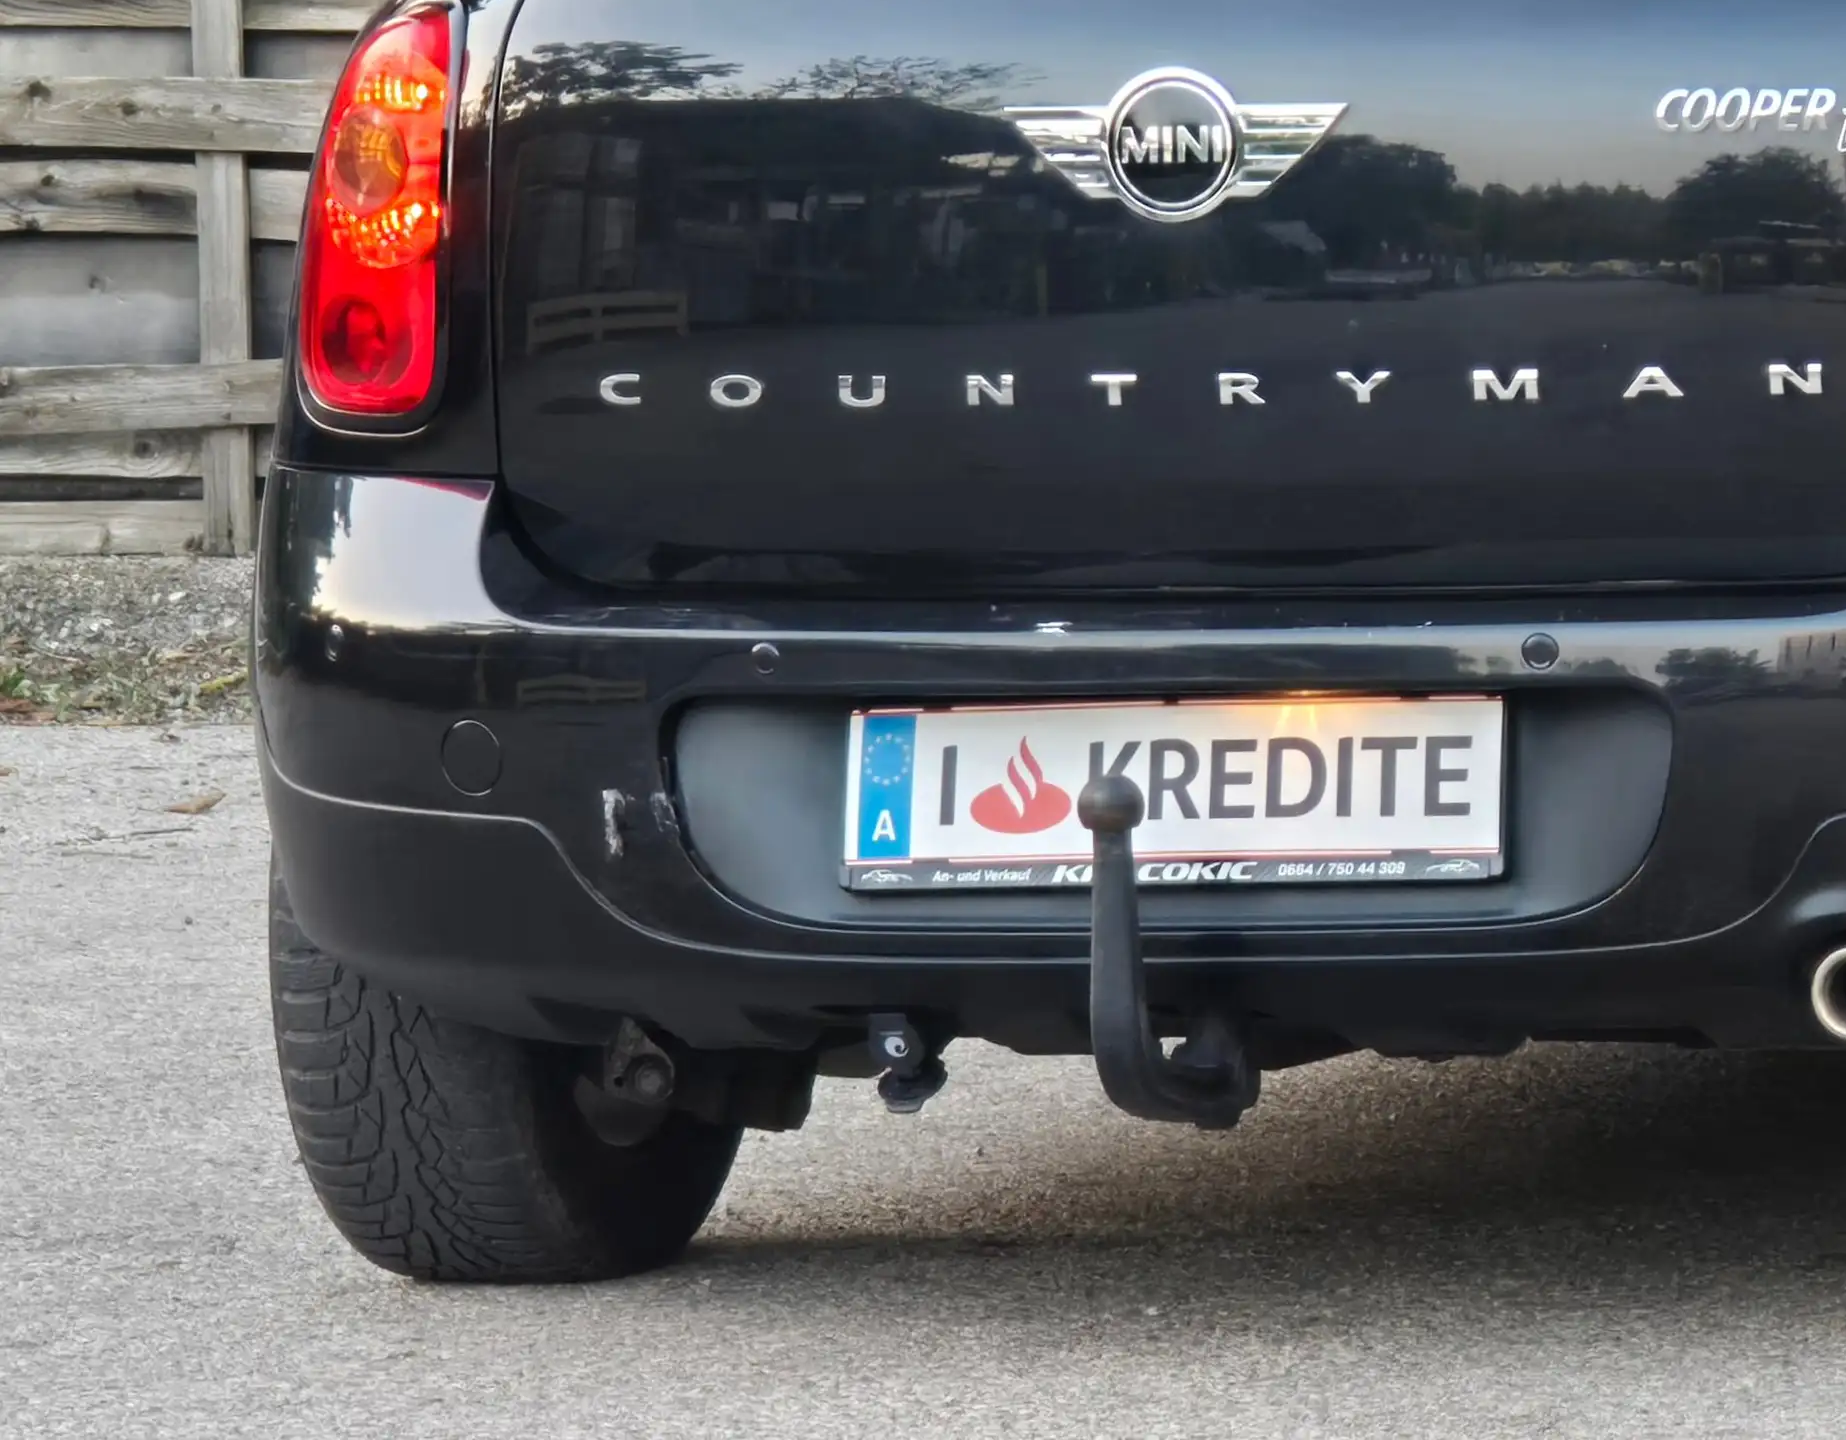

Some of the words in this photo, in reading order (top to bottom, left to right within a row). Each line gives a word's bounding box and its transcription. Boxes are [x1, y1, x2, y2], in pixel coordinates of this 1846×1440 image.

[1655, 87, 1837, 132] COOPER
[1120, 124, 1224, 165] MINI
[599, 363, 1823, 408] COUNTRYMAN
[939, 744, 959, 827] I
[871, 808, 897, 842] A
[956, 867, 982, 882] und
[984, 867, 1033, 882] Verkauf
[1357, 861, 1376, 875] 44
[1378, 861, 1406, 875] 309
